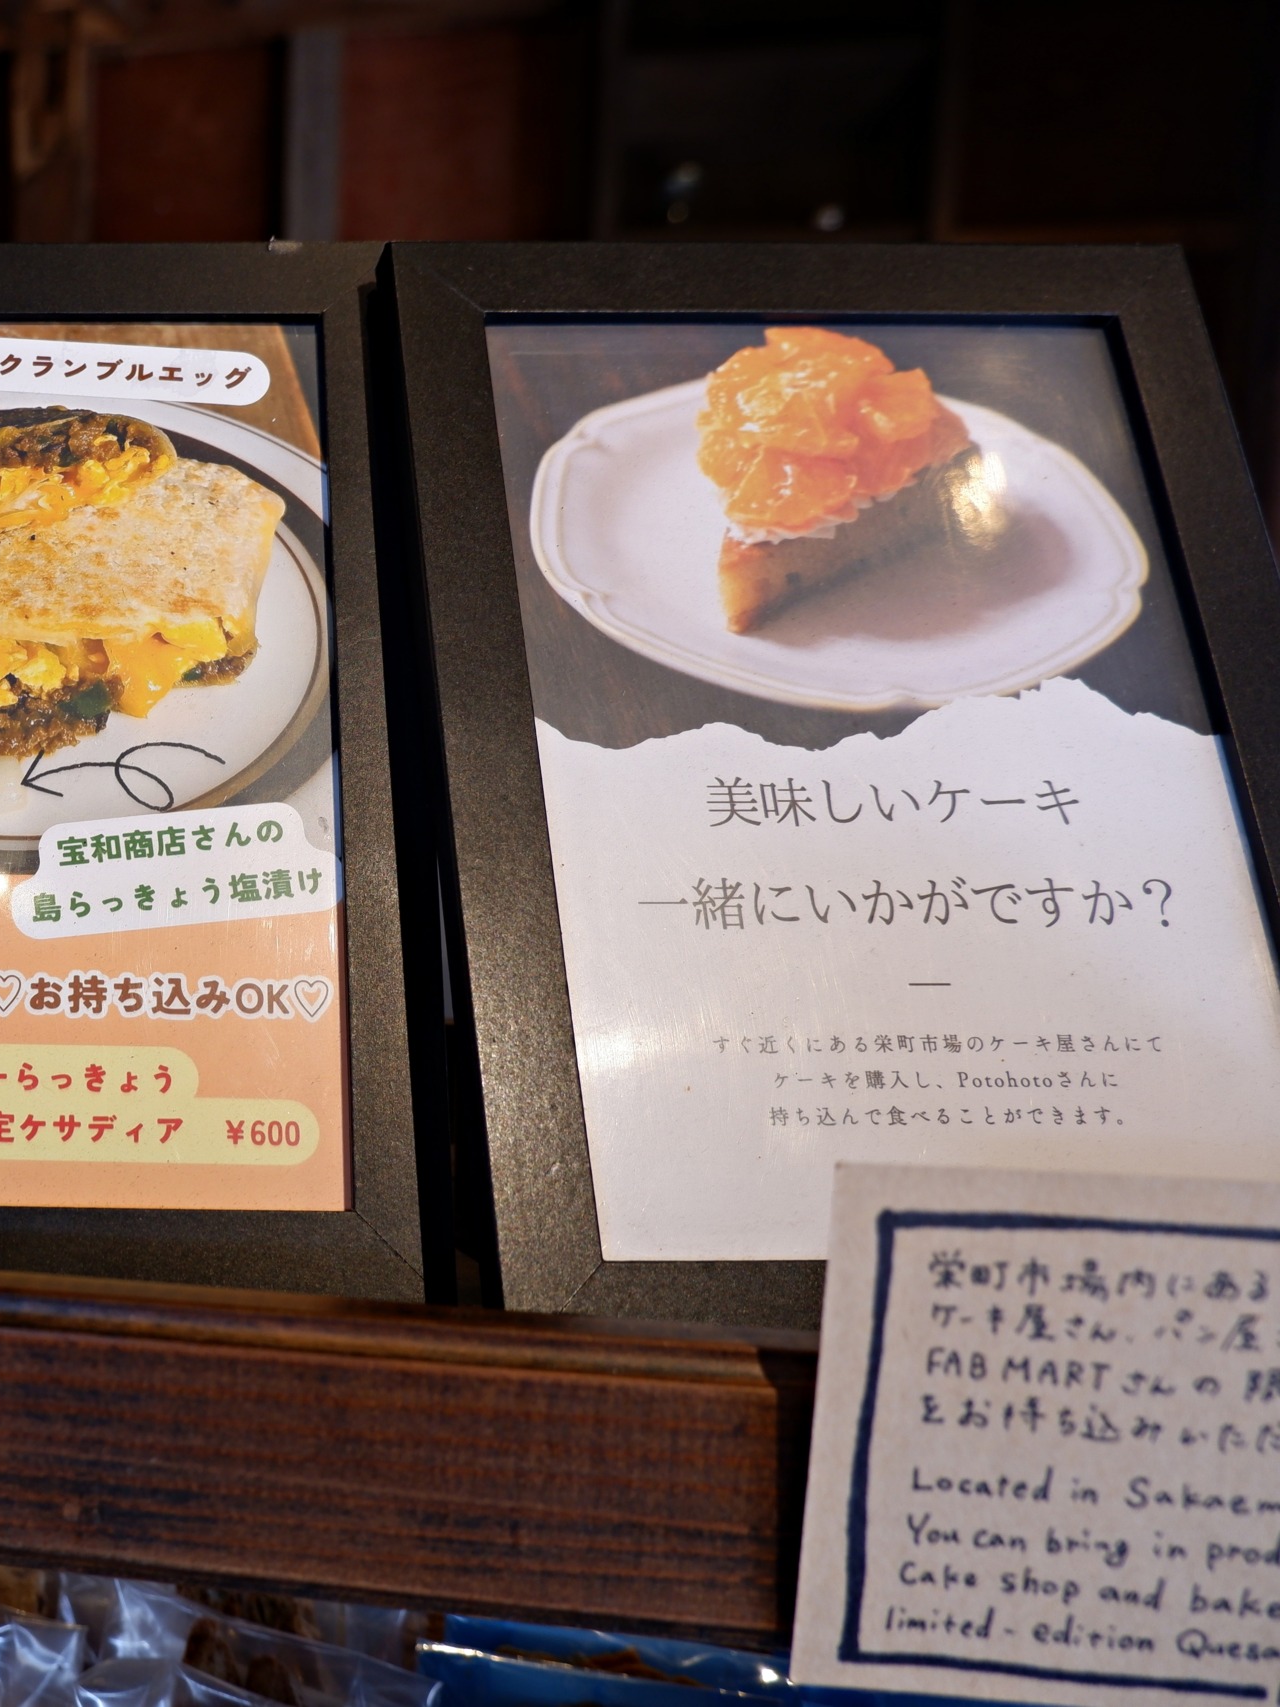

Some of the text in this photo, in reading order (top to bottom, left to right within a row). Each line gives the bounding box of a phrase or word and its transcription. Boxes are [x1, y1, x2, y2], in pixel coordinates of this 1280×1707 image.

[706, 777, 1080, 827] 美味しいケーキ
[57, 820, 283, 866] 宝和商店さんの
[32, 868, 322, 922] 島らっきょう塩漬け
[637, 876, 1173, 930] 一緒にいかがですか?
[712, 1034, 1162, 1053] すぐ近くにある栄町市場のケーキ屋さんにて
[773, 1069, 1119, 1089] ケーキを購入し、Potohotoさんに
[226, 1118, 300, 1147] ¥600
[769, 1106, 1124, 1126] 持ち込んで食べることができます。
[913, 1466, 1053, 1502] Located
[1072, 1477, 1099, 1505] in
[907, 1513, 960, 1547] You
[973, 1528, 1027, 1552] can
[1046, 1526, 1129, 1568] bring
[1153, 1530, 1187, 1560] in
[899, 1561, 978, 1589] Cake
[1001, 1569, 1080, 1604] shop
[1099, 1576, 1166, 1612] and
